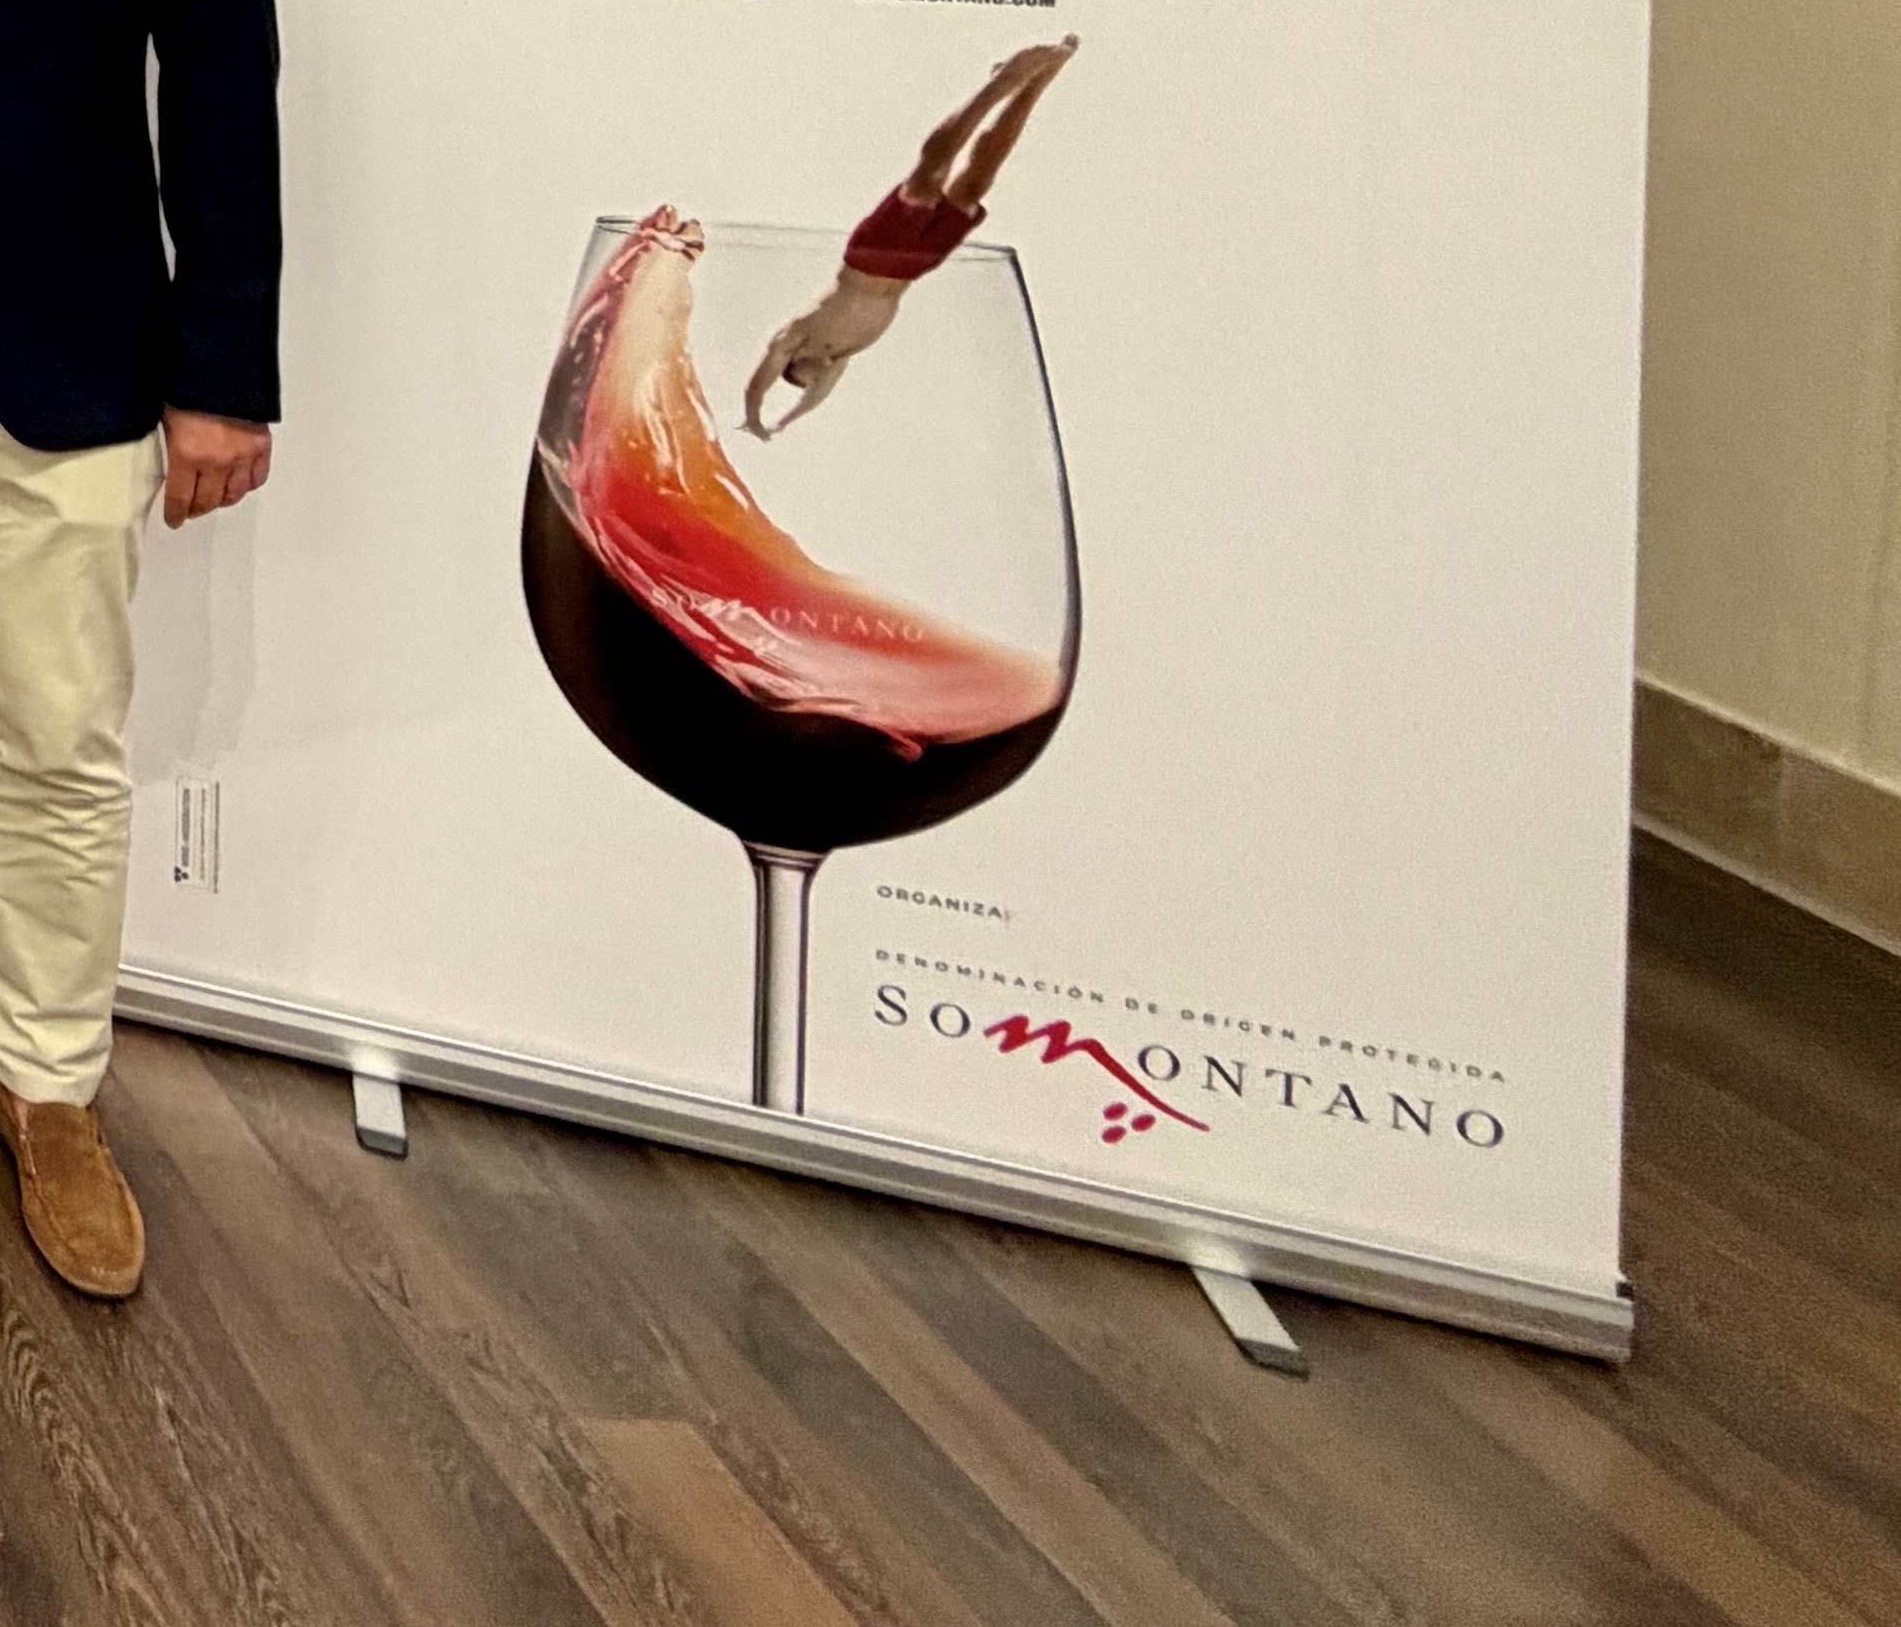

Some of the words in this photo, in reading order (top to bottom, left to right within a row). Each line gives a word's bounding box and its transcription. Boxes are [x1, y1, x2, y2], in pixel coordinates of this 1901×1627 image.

[875, 948, 1105, 1004] DENOMINACIÓN
[1125, 997, 1159, 1015] DE
[1181, 1008, 1296, 1042] ORIGEN
[1319, 1034, 1505, 1083] PROTEGIDA
